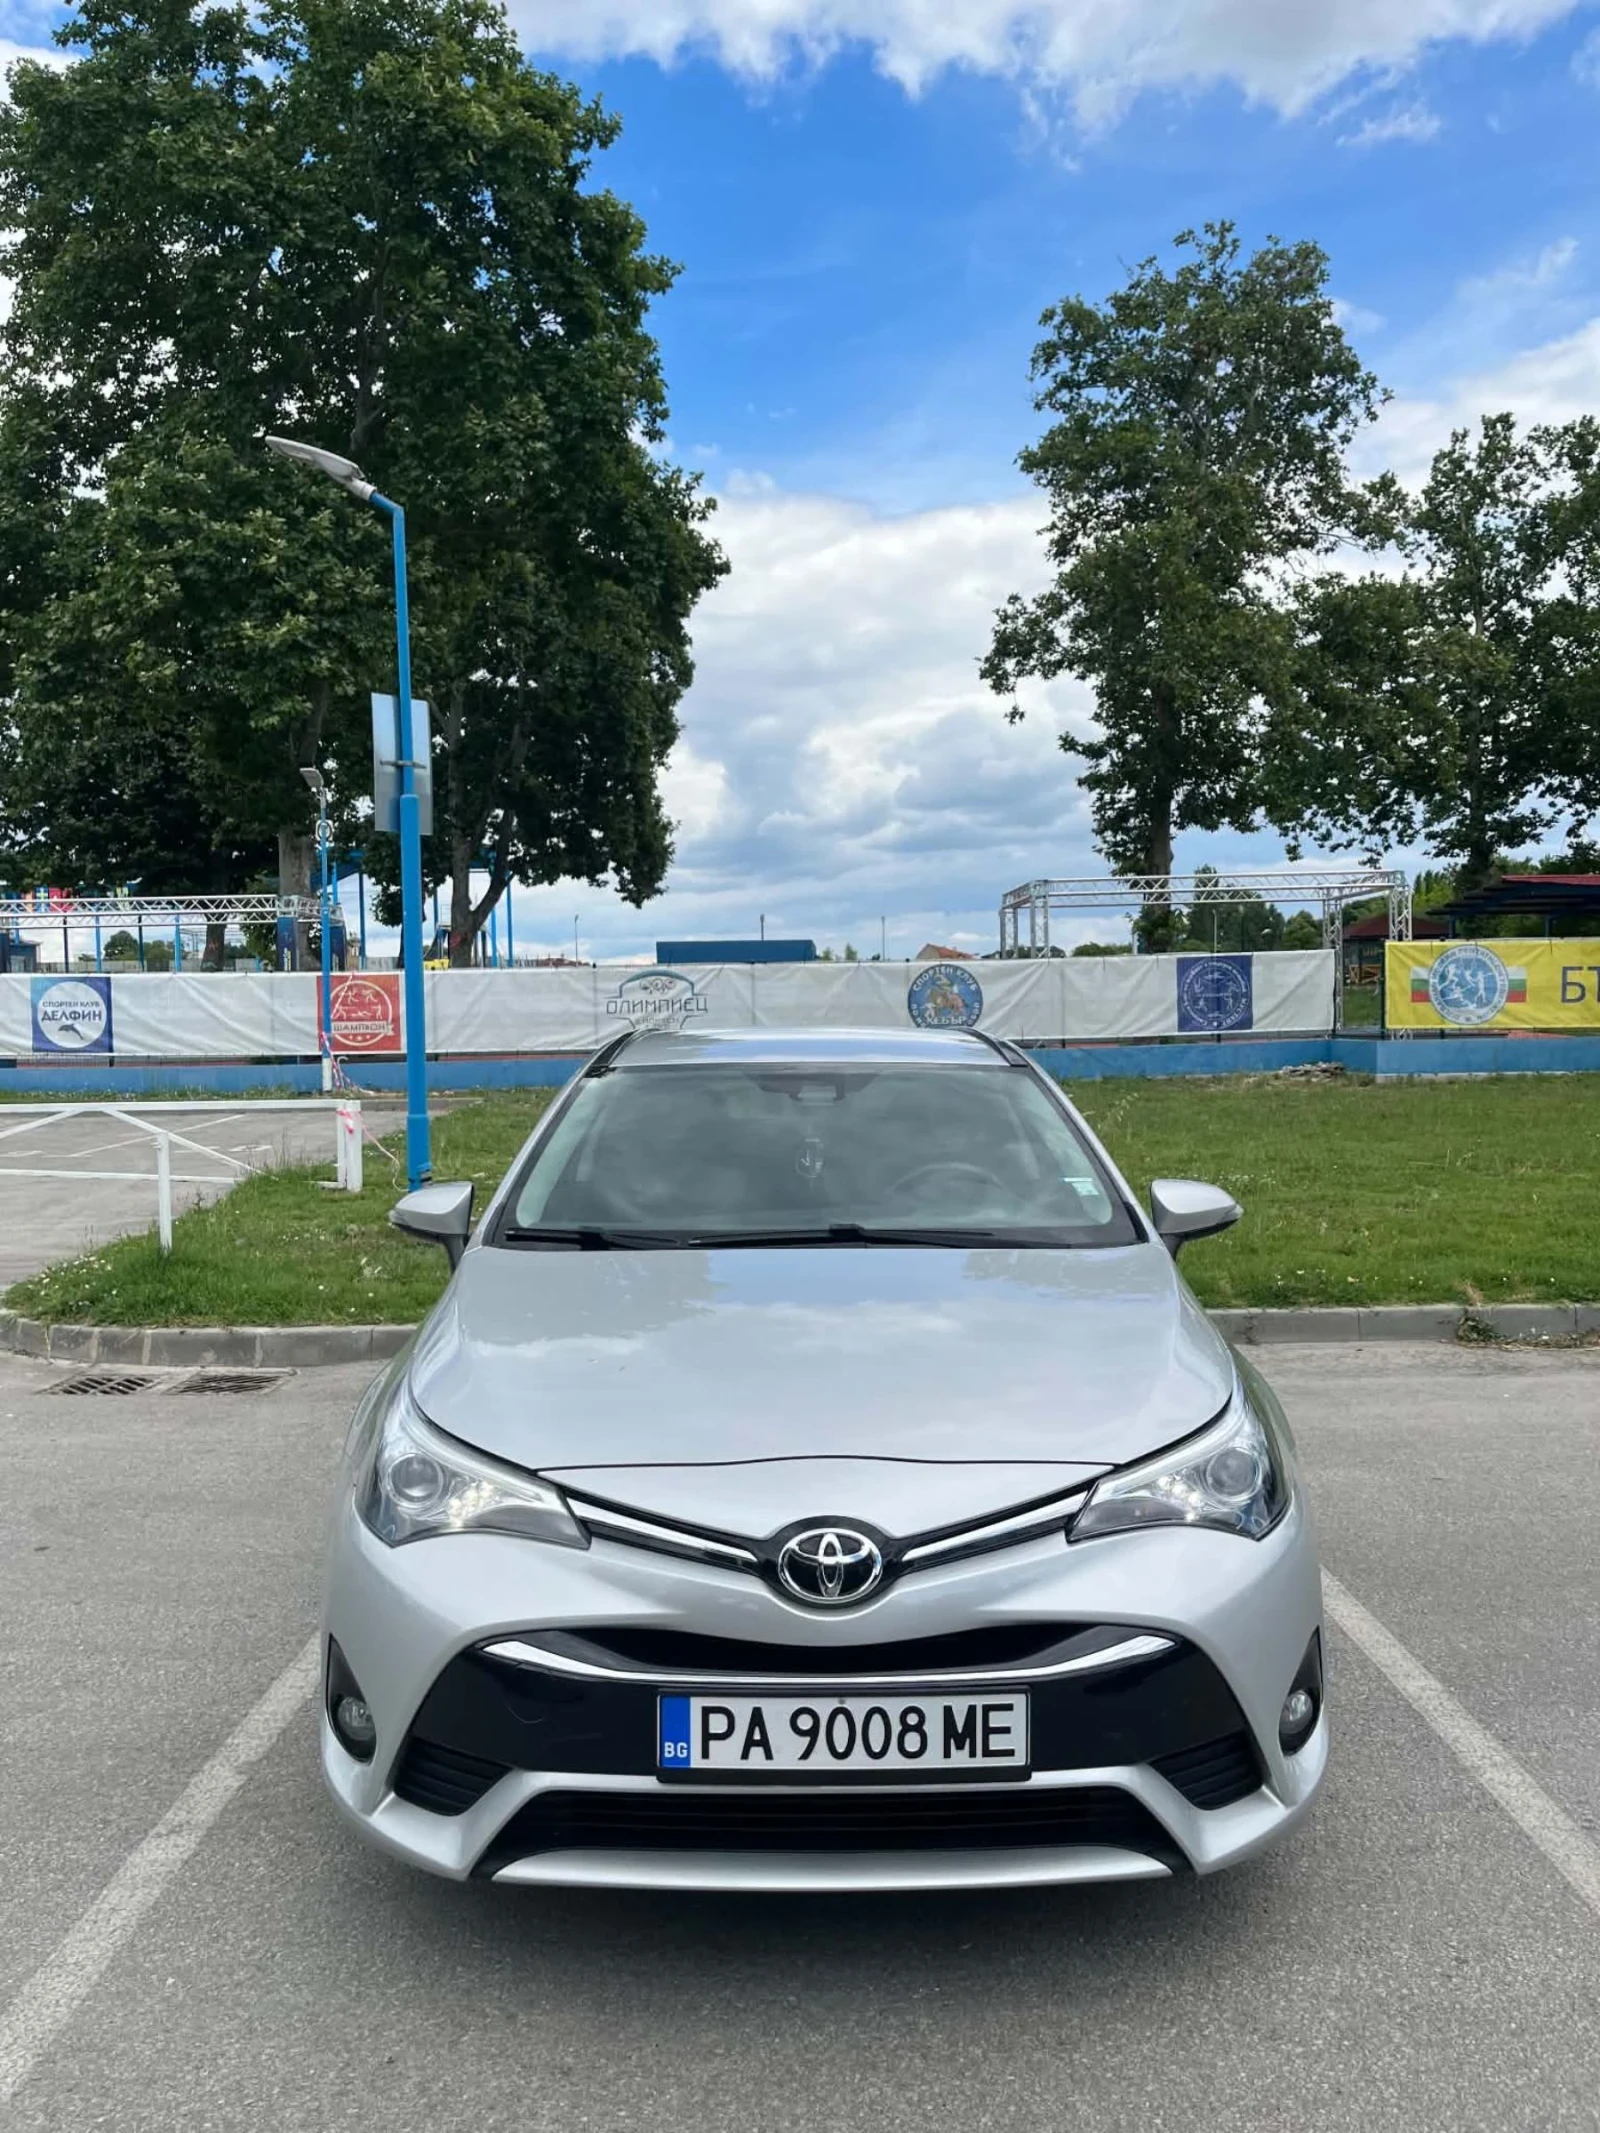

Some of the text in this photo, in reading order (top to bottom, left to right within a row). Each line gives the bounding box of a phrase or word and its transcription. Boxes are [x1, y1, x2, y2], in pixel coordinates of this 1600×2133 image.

[606, 997, 708, 1015] ОЛИМПИЕЦ
[41, 1010, 102, 1022] ДЕЛФИН
[701, 1703, 1015, 1760] PA 9008 ME
[664, 1742, 688, 1758] BG
